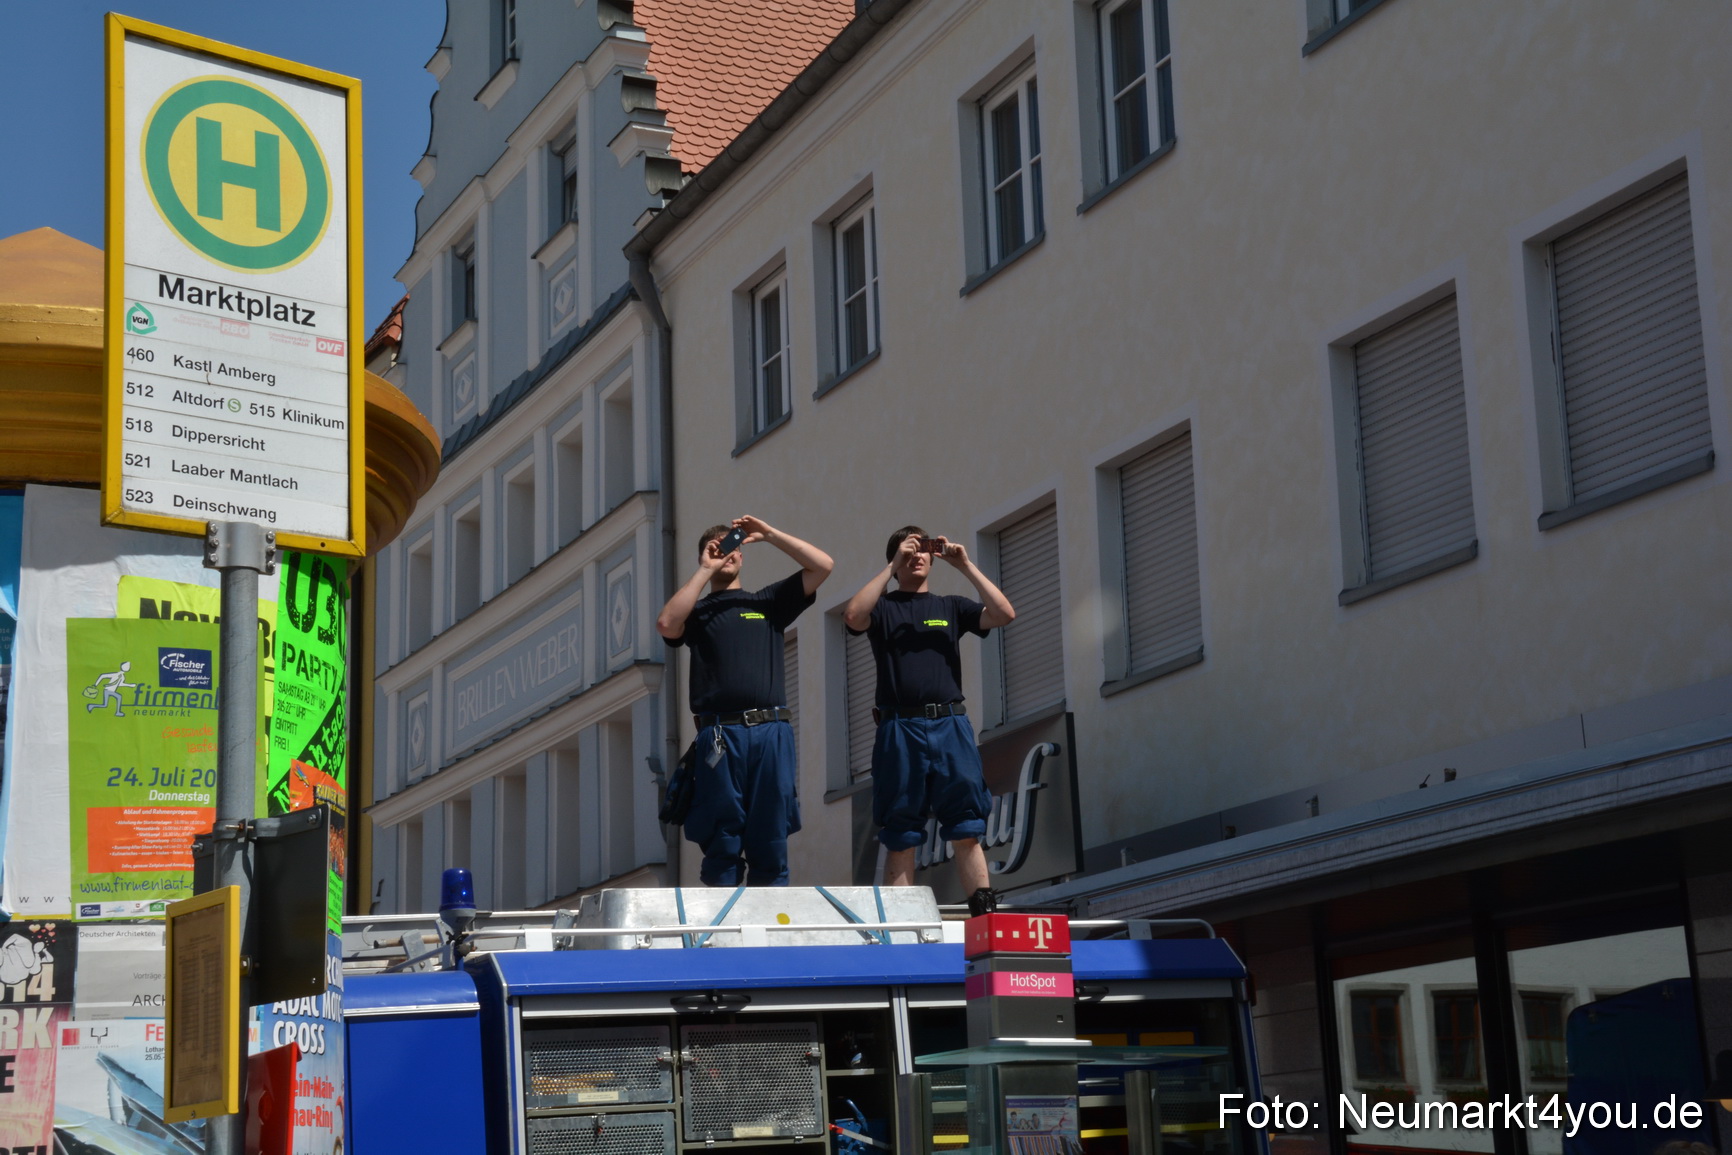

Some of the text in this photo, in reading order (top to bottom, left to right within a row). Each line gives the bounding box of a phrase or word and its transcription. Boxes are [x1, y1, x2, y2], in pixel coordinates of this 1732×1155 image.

[196, 116, 281, 232] H
[158, 274, 316, 327] Marktplatz
[132, 315, 149, 326] VGN
[317, 340, 342, 354] OVF
[126, 347, 276, 387] 460 Kastl Amberg
[126, 382, 154, 398] 512
[172, 390, 224, 410] Altdorf
[249, 403, 276, 418] 515
[282, 408, 345, 430] Klinikum
[125, 417, 266, 451] 518 Dippersricht
[125, 453, 298, 490] 521 Laaber Mantlach
[125, 489, 277, 523] 523 Deinschwang
[169, 659, 205, 670] Fischer
[281, 641, 338, 695] PARTY
[457, 623, 579, 731] BRILLEN WEBER
[134, 683, 219, 709] firmenl
[134, 708, 191, 717] neumarkt
[107, 767, 217, 788] 24. Juli 20
[149, 789, 210, 805] Donnerstag
[116, 930, 156, 938] Architekten
[1028, 917, 1053, 949] T
[133, 972, 162, 981] Vorträge
[1010, 973, 1056, 990] HotSpot
[272, 1020, 325, 1056] CROSS
[294, 1104, 333, 1134] nau-Ring
